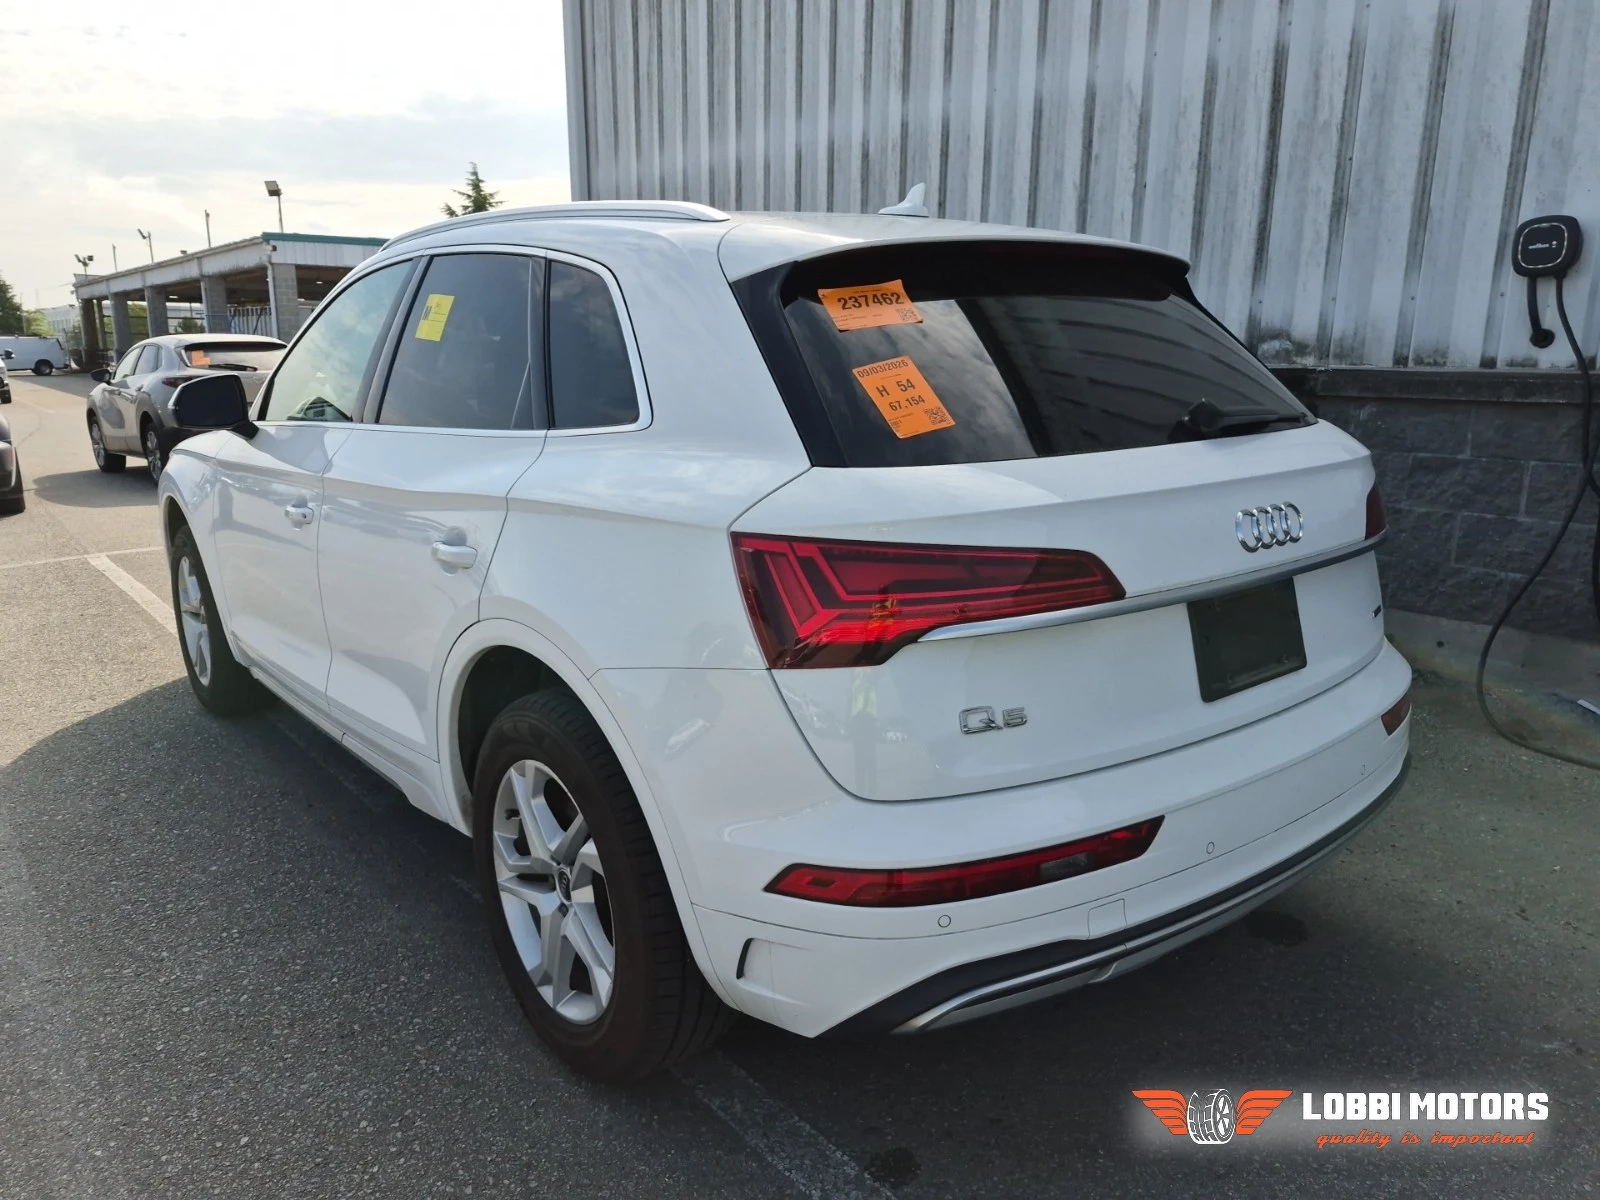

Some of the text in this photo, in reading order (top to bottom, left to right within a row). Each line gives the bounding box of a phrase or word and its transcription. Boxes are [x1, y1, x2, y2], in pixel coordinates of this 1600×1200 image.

[837, 292, 904, 310] 237462
[857, 359, 908, 378] 09/03/2026
[876, 378, 915, 397] H 54
[959, 705, 1028, 735] Q5
